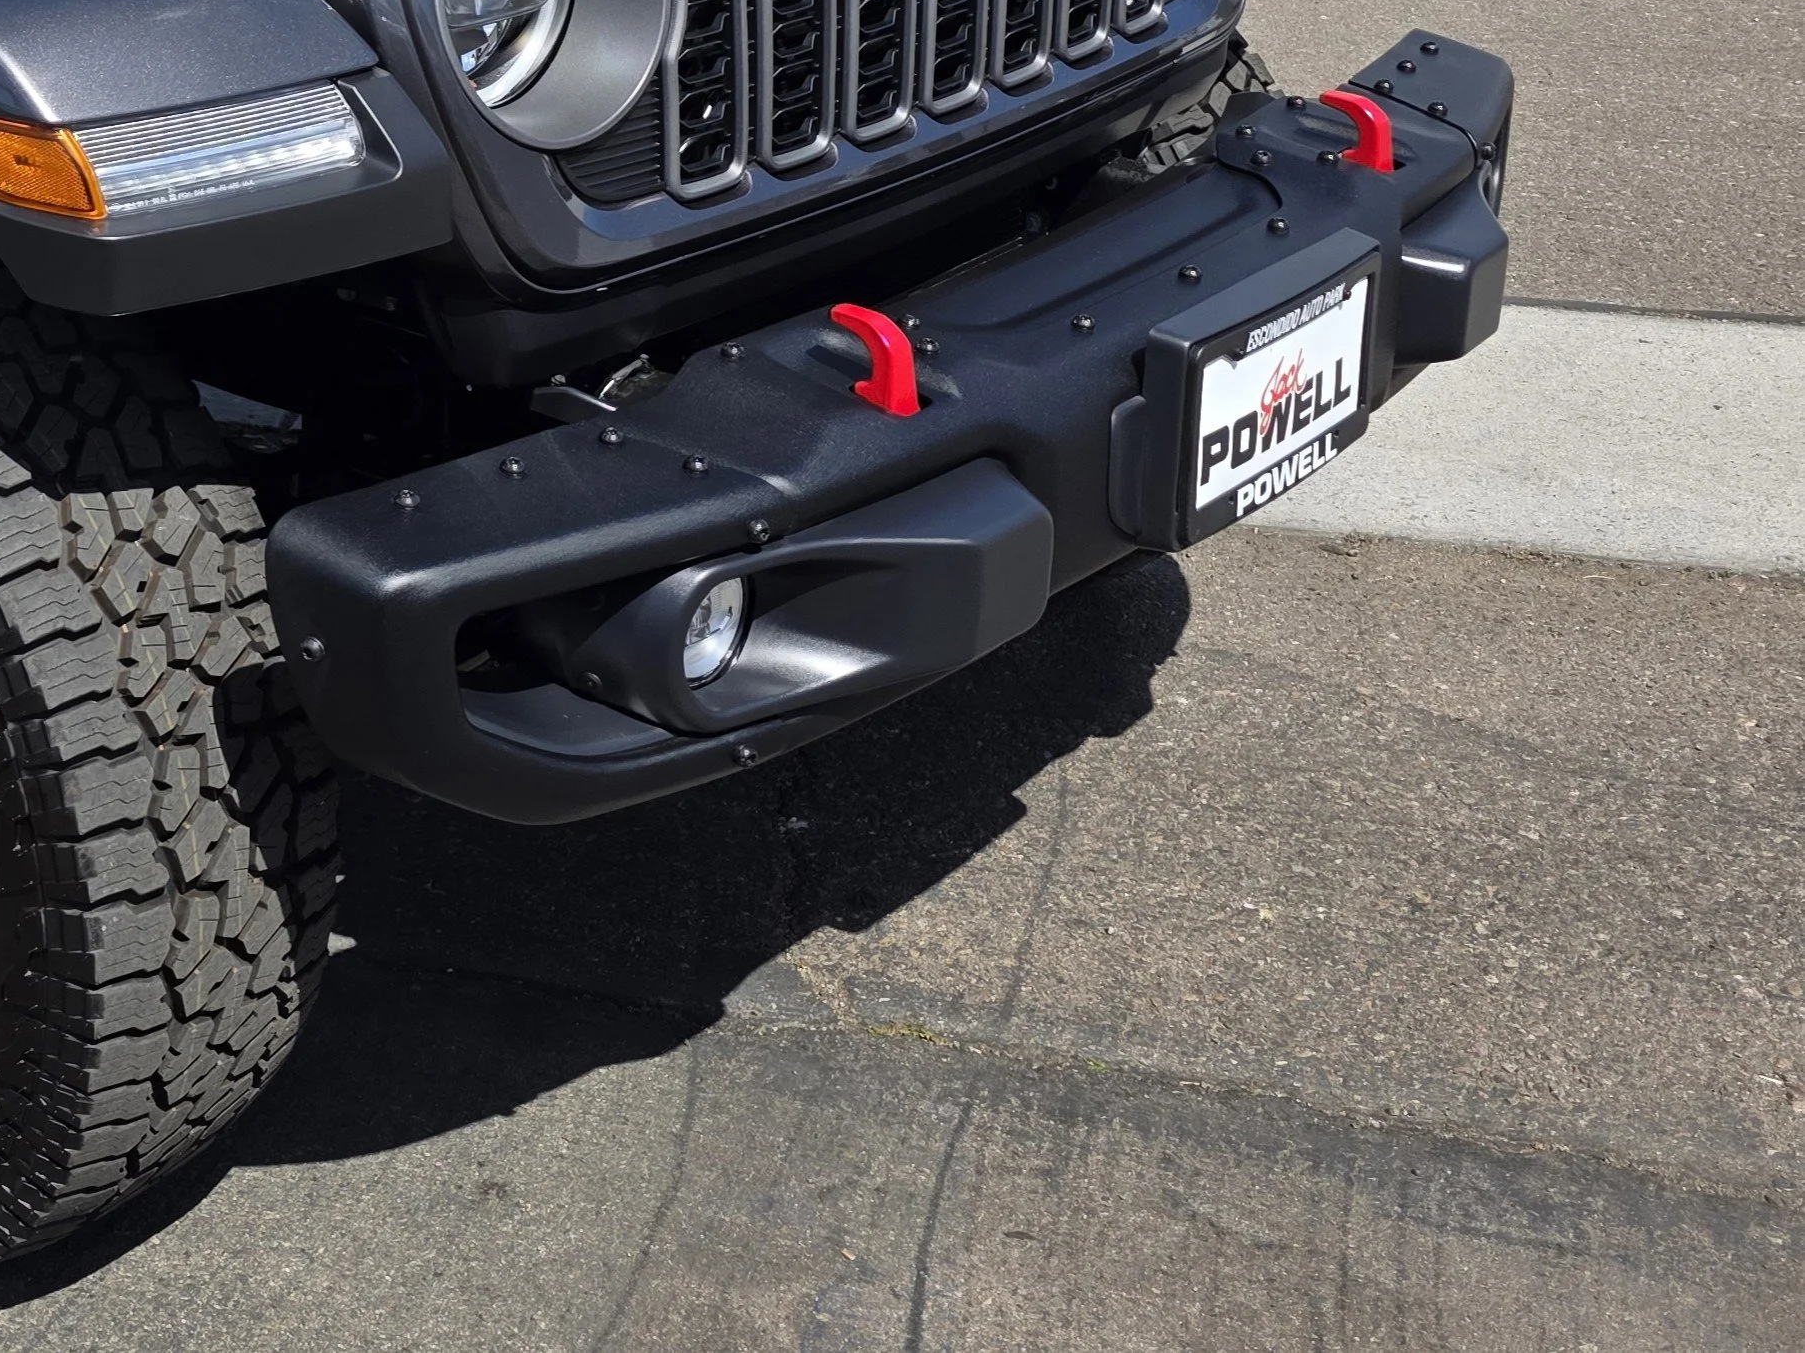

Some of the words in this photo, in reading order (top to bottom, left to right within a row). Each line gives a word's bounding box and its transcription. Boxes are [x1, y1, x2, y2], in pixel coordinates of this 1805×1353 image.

[1246, 307, 1302, 352] ESCONDIDO
[1299, 294, 1325, 325] AUTO
[1200, 357, 1351, 486] POWELL
[1236, 432, 1338, 517] POWELL
